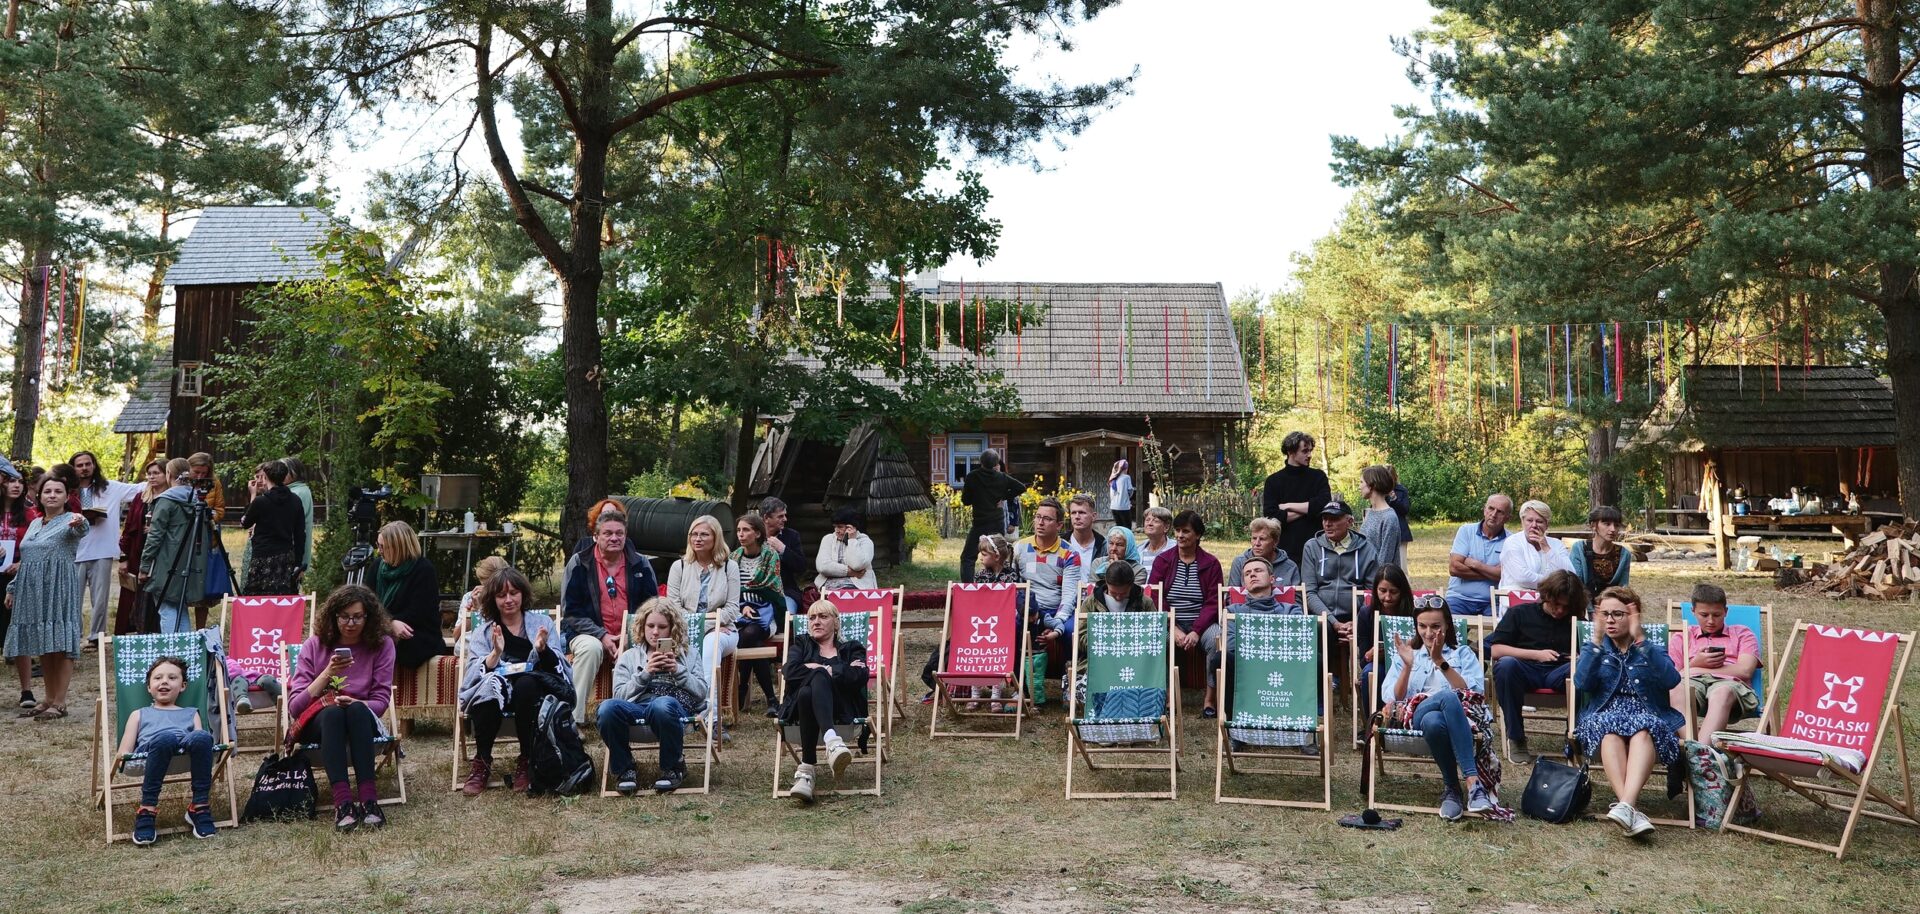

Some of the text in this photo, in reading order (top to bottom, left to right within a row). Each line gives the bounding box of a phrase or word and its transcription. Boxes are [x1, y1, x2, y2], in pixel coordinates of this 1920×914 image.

[957, 647, 1009, 656] PODLASKI
[237, 657, 289, 667] PODLASK
[956, 656, 1008, 664] INSTYTUT
[955, 664, 1007, 672] KULTURY
[1257, 689, 1294, 697] PODLASKA
[1795, 710, 1870, 732] PODLASKI
[1791, 723, 1867, 746] INSTYTUT
